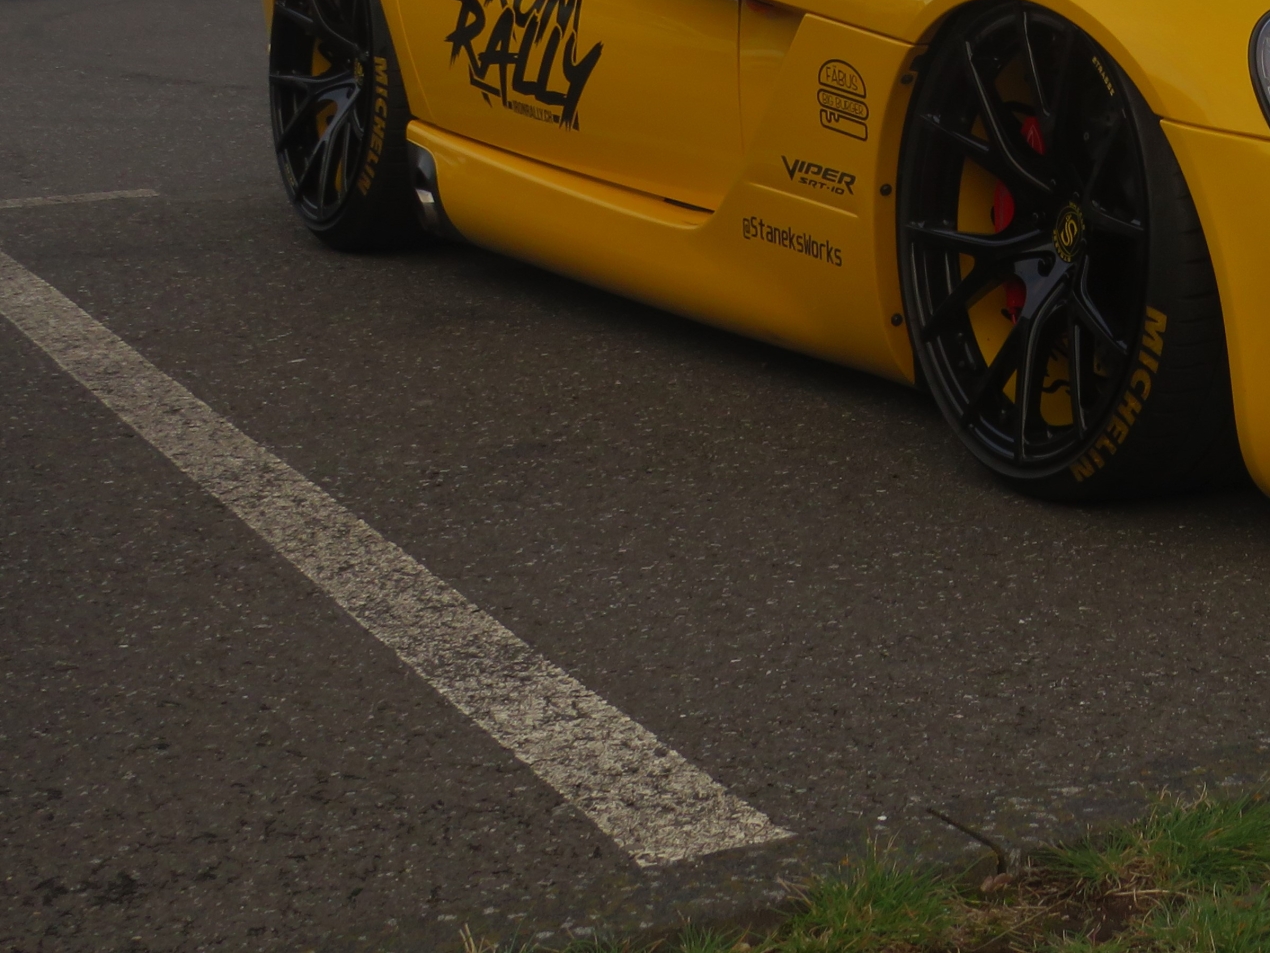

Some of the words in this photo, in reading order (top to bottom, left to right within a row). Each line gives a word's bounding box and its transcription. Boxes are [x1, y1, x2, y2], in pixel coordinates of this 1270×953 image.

[825, 65, 859, 92] FÄBUS
[357, 56, 389, 196] MICHELIN
[821, 92, 835, 107] BIG
[834, 96, 865, 117] BURGER
[780, 155, 857, 195] VIPER
[742, 216, 843, 268] @StaneksWorks
[1070, 305, 1167, 483] MICHELIN
